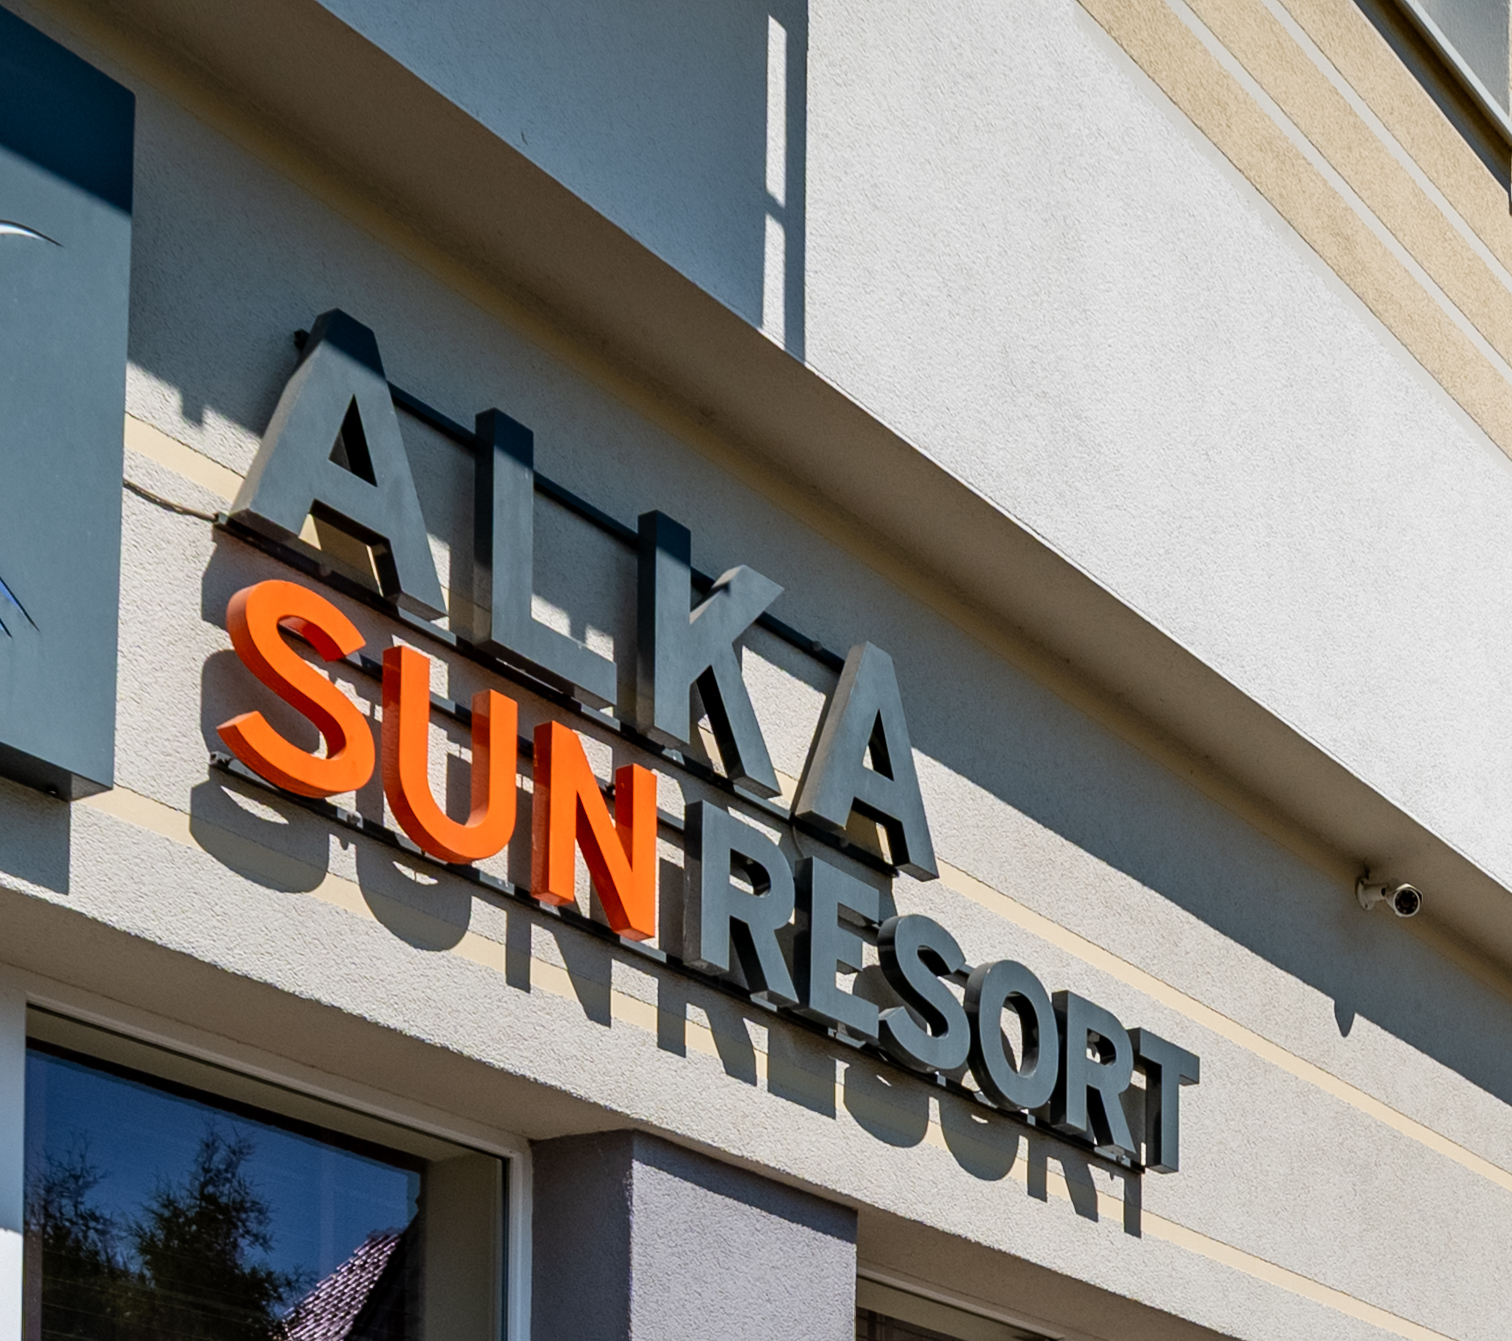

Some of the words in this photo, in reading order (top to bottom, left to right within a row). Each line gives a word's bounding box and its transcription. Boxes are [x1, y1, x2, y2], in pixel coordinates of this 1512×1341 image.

[215, 578, 658, 941] SUN
[686, 800, 1201, 1174] RESORT
[231, 308, 939, 880] ALKA
